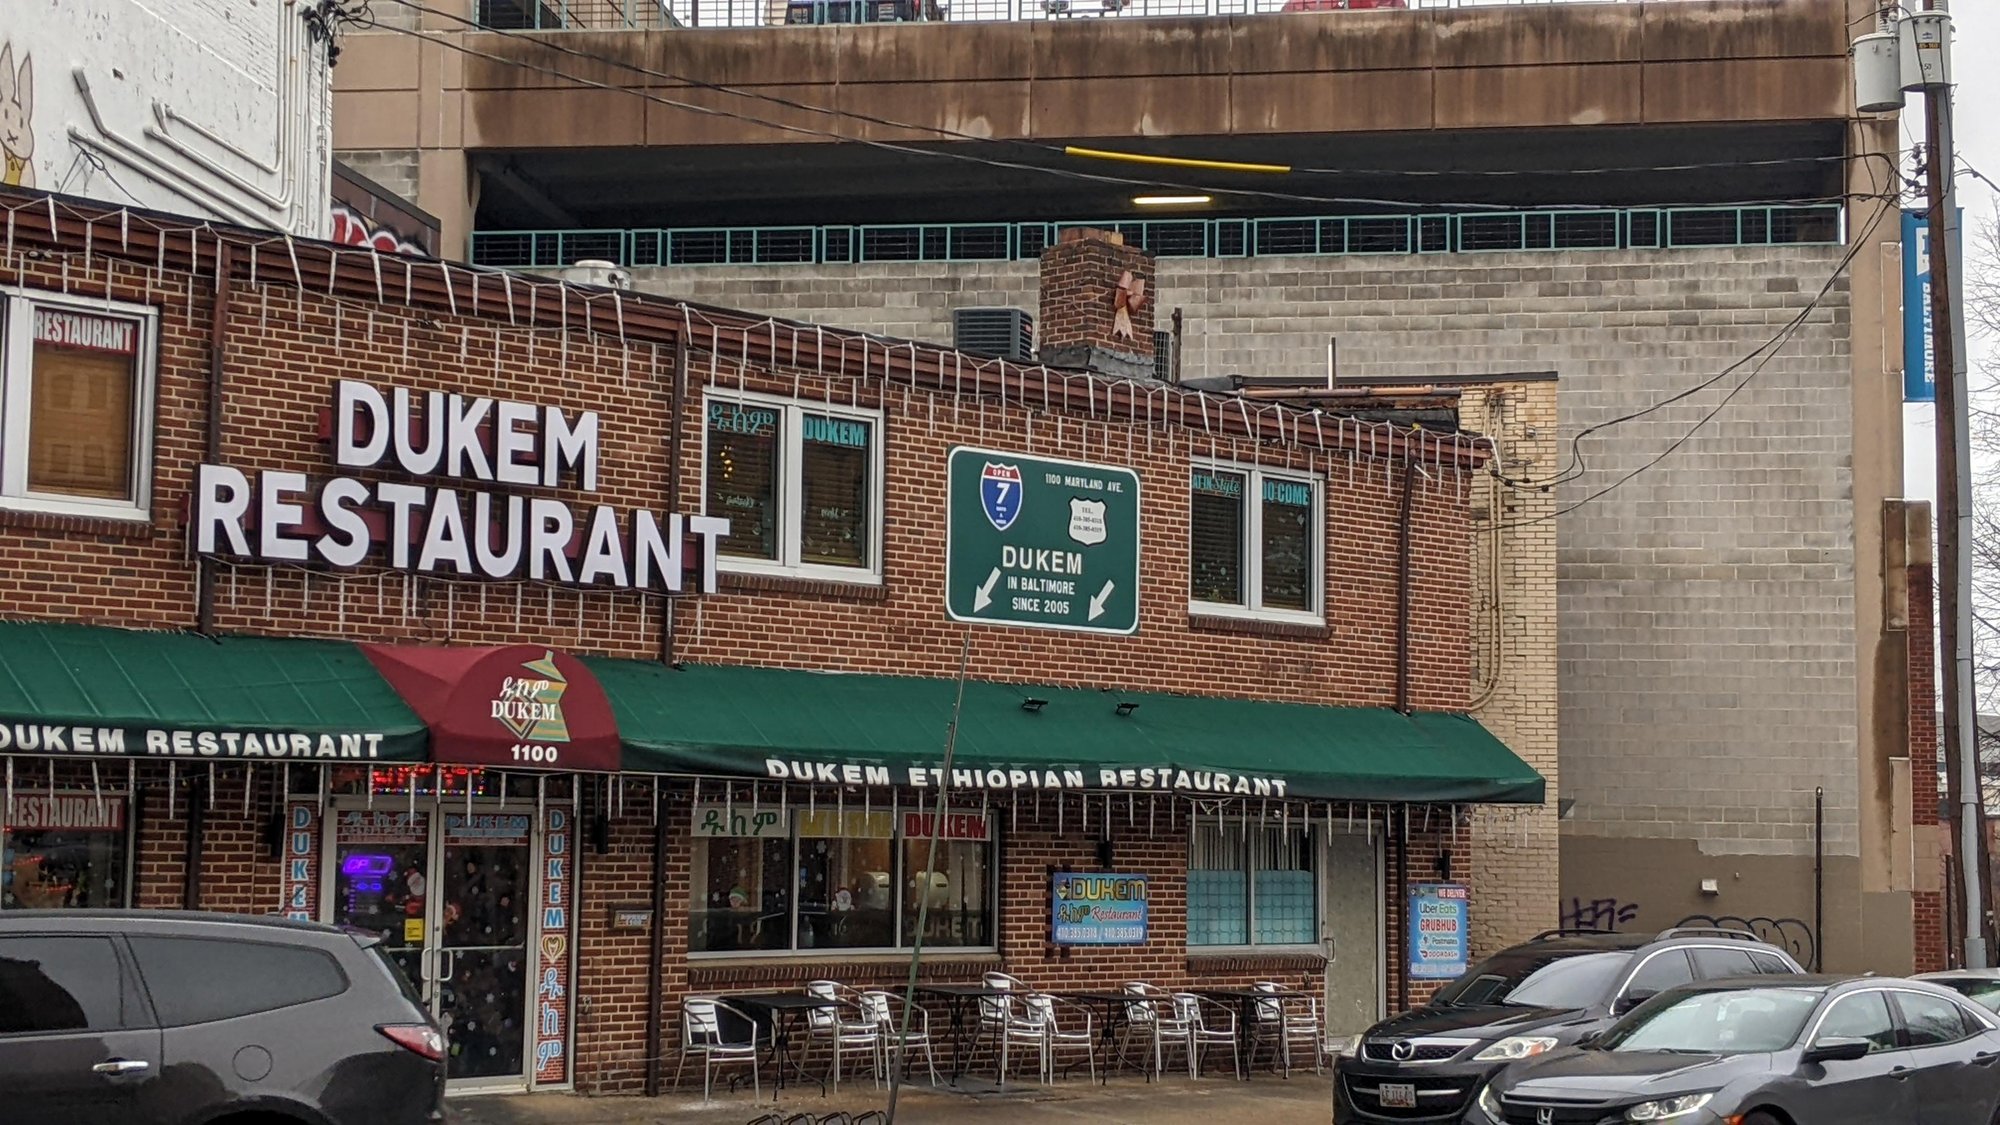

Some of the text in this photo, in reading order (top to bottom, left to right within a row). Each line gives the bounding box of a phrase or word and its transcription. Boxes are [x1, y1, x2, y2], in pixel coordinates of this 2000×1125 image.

[34, 310, 133, 351] RESTAURANT
[337, 379, 598, 491] DUKEM
[803, 417, 866, 446] DUKEM
[992, 469, 1011, 478] OPEN
[1045, 473, 1124, 493] 1100 MARYLAND AVE.
[996, 482, 1011, 505] 7
[1277, 483, 1310, 506] COME
[197, 463, 731, 594] RESTAURANT
[1002, 545, 1082, 575] DUKEM
[1007, 576, 1075, 595] IN BALTIMORE
[1012, 597, 1070, 614] SINCE 2005
[490, 700, 556, 721] DUKEM
[146, 729, 384, 758] RESTAURANT
[511, 744, 558, 762] 1100
[765, 759, 1287, 797] DUKEM ETHIOPIAN RESTAURANT
[5, 797, 121, 827] RESTAURANT
[905, 813, 987, 838] DUKEM
[544, 809, 566, 928] DUKEM
[1072, 878, 1146, 900] DUKEM
[1091, 905, 1143, 922] Restaurant
[1420, 903, 1457, 914] Uber Eats
[1420, 919, 1457, 931] GRUBHUB
